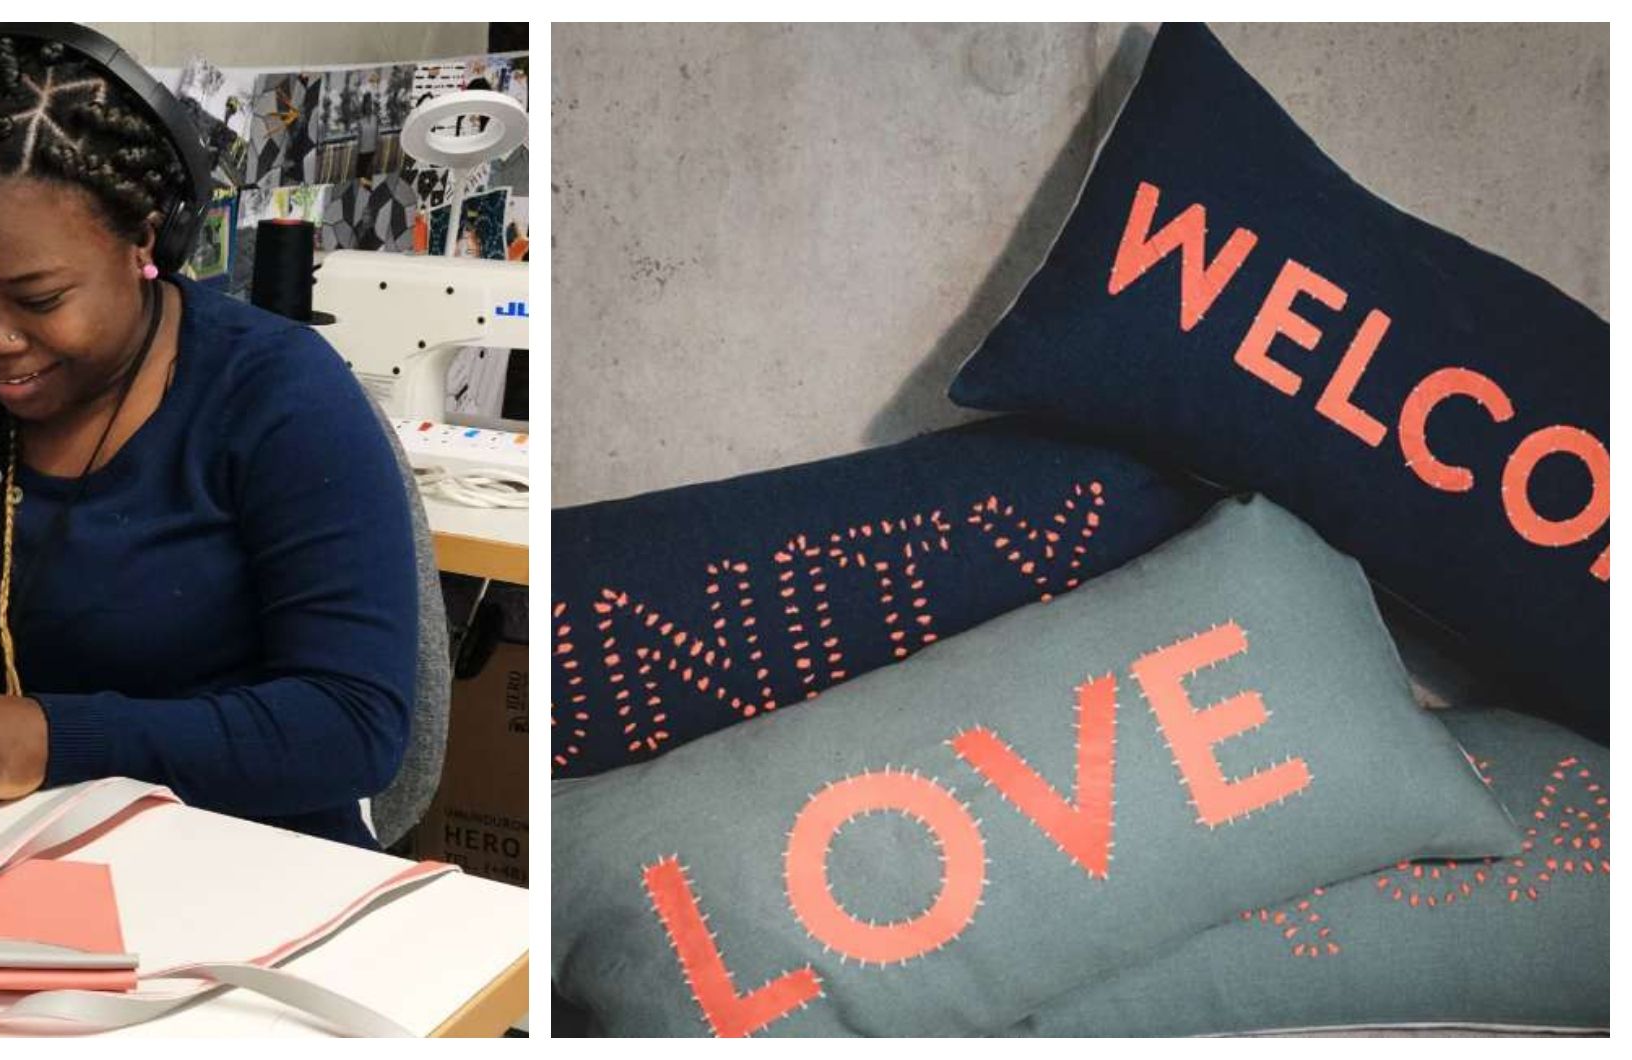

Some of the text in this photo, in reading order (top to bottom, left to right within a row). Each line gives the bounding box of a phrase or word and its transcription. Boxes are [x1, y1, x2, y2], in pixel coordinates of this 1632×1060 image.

[1108, 181, 1610, 580] WELCO
[551, 481, 1105, 768] NITY
[444, 824, 520, 858] HERO
[642, 619, 1313, 1038] LOVE
